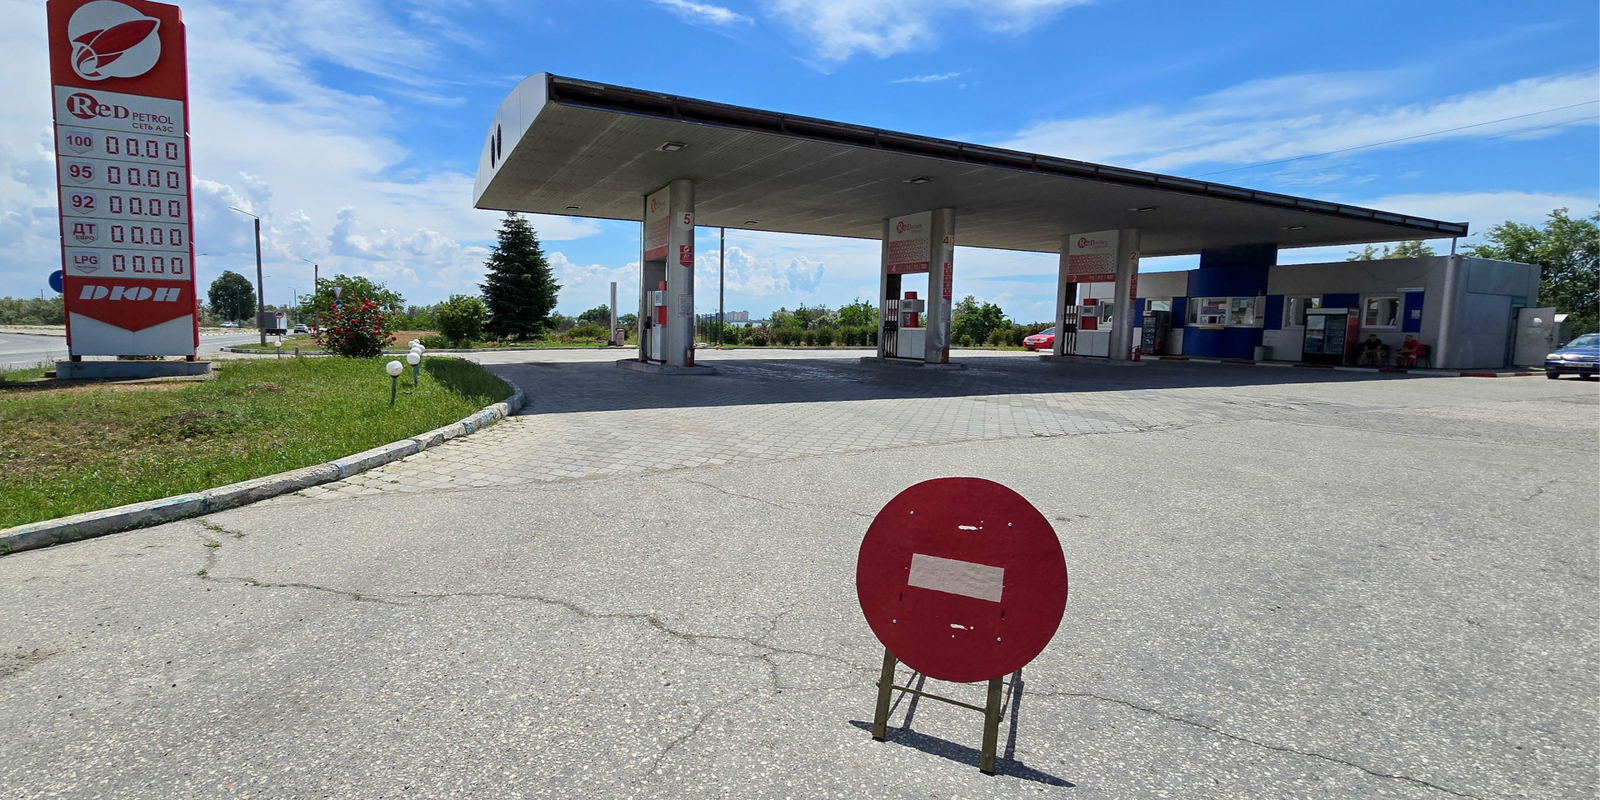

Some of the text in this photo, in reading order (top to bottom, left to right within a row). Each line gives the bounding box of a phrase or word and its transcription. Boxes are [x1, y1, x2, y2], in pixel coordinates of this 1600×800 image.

[132, 112, 174, 125] PETROL
[131, 122, 174, 133] СЕТЬ АЗС
[66, 135, 93, 147] 100
[69, 164, 93, 179] 95
[71, 194, 95, 208] 92
[684, 214, 690, 224] 5
[73, 223, 96, 235] ДТ
[74, 255, 98, 265] LPG
